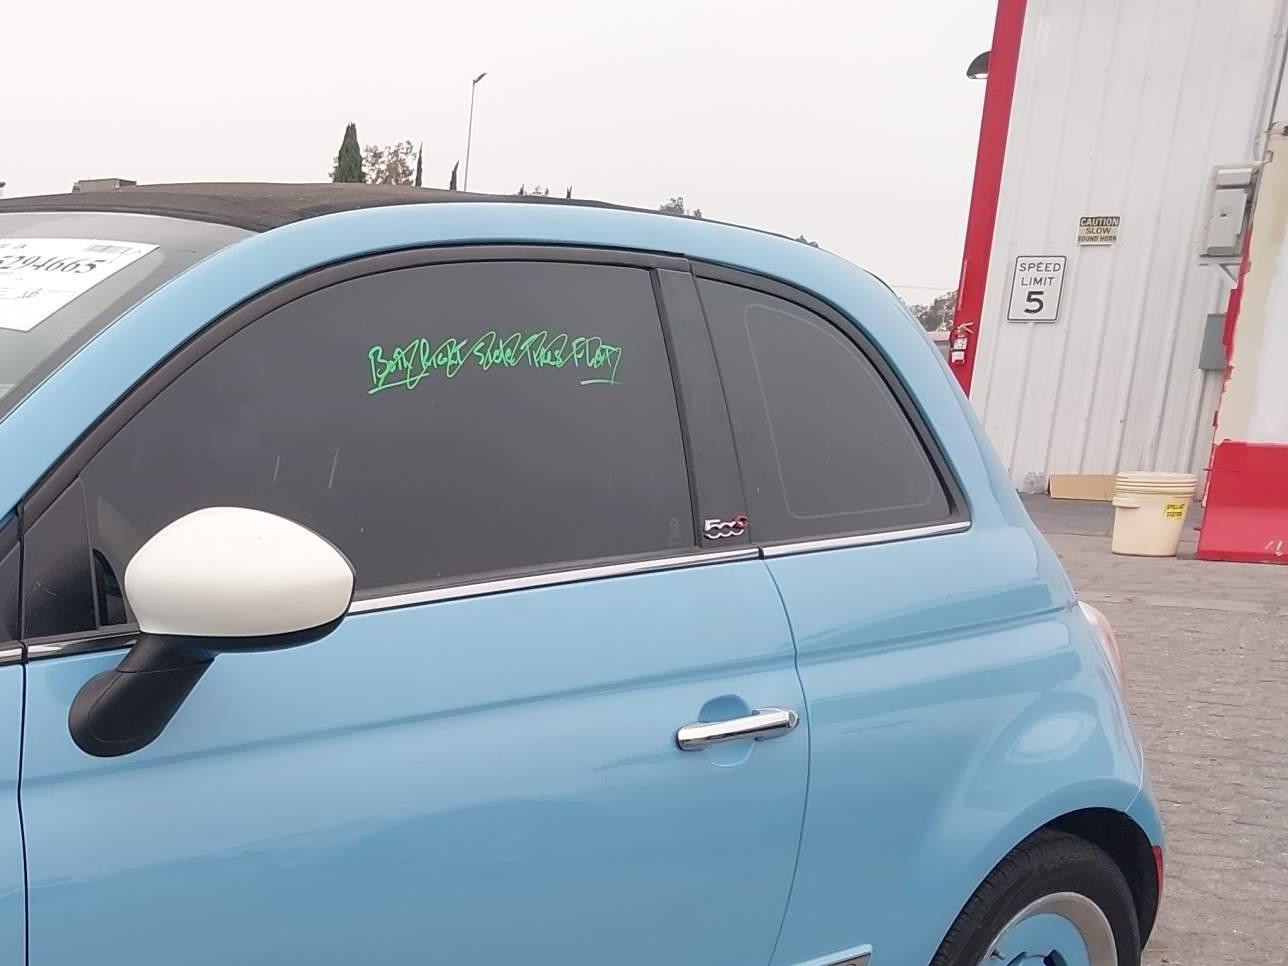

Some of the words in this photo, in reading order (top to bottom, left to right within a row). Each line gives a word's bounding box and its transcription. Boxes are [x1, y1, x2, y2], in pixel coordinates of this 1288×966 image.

[1081, 217, 1120, 226] CAUTION
[1086, 227, 1112, 235] SLOW
[1019, 262, 1062, 272] SPEED
[1021, 276, 1056, 286] LIMIT
[1024, 290, 1044, 314] 5
